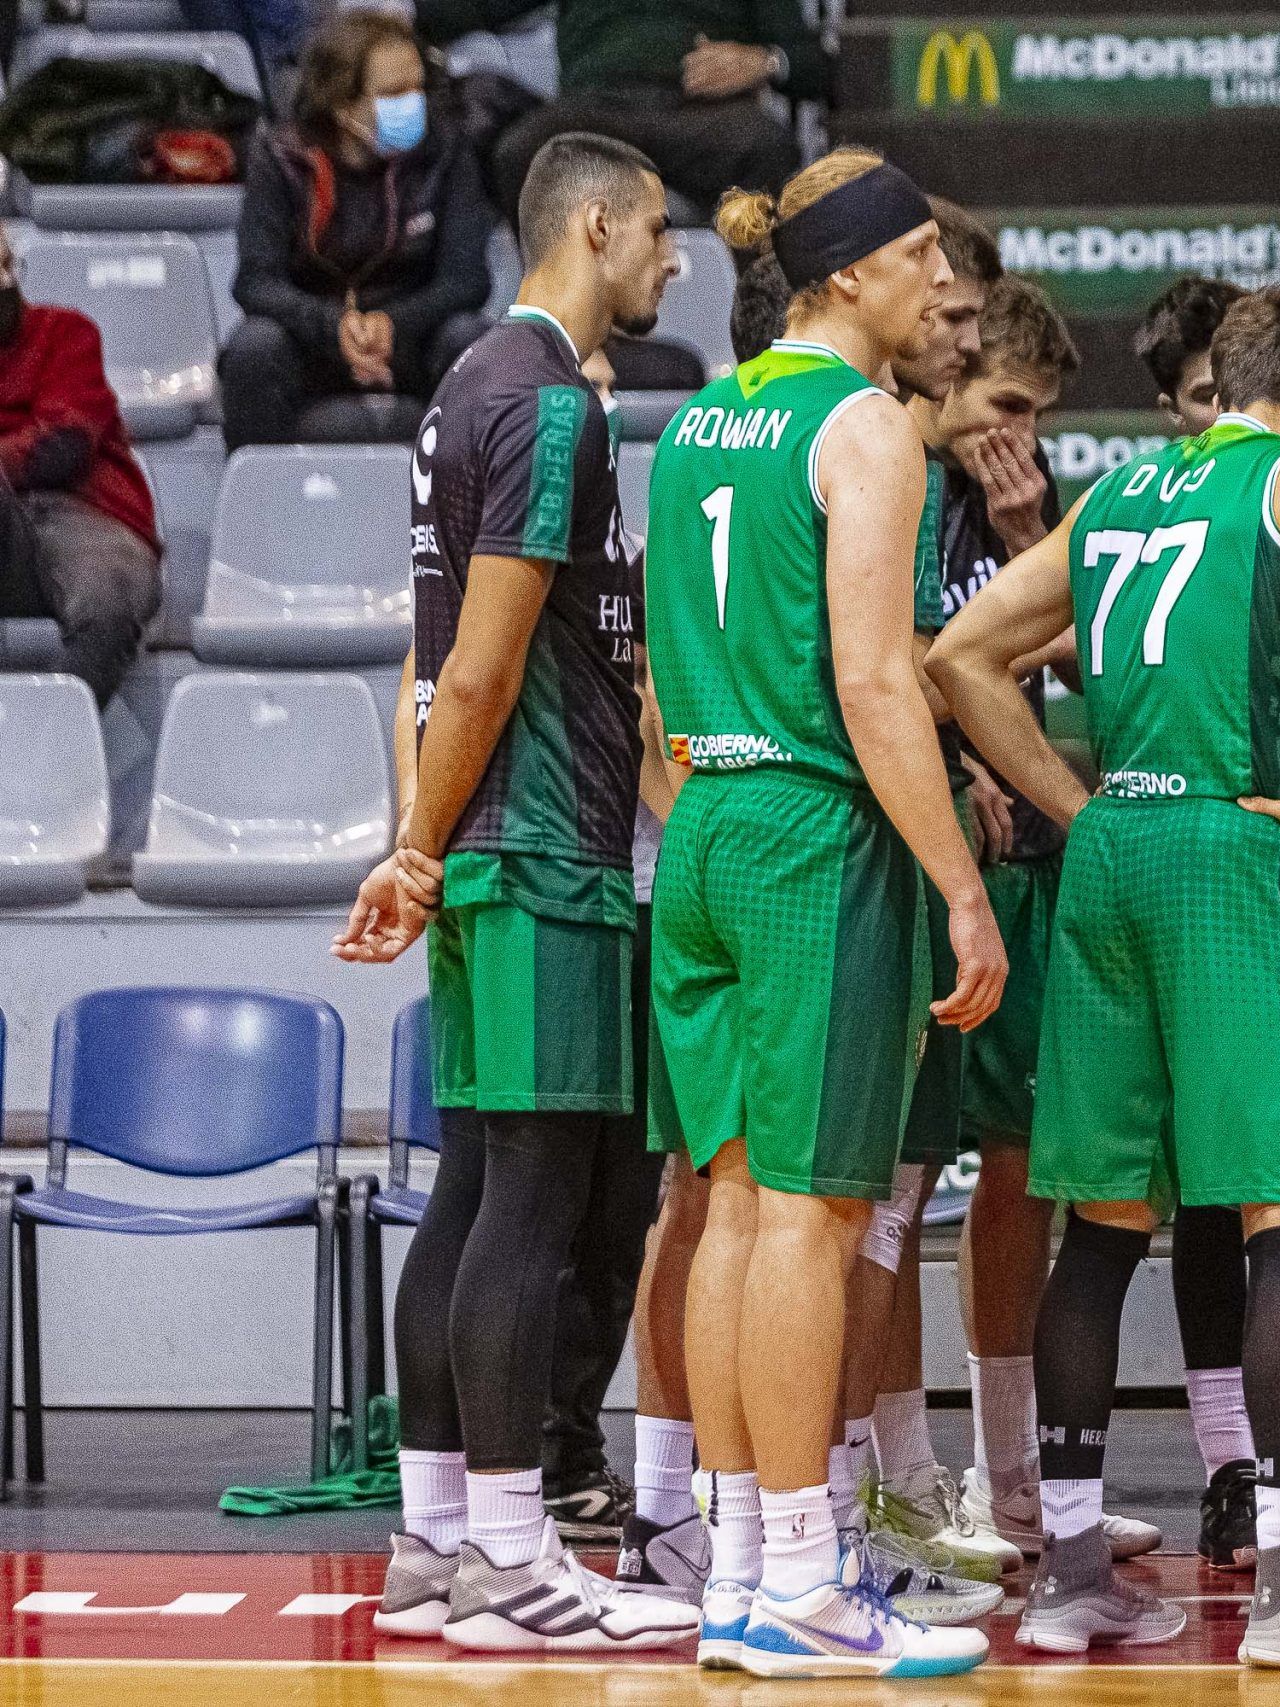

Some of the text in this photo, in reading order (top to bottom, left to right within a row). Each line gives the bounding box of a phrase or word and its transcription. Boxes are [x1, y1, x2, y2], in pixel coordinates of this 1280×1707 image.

[674, 406, 792, 450] ROWAN
[700, 485, 734, 630] 1
[1083, 520, 1209, 677] 77
[689, 733, 780, 757] GOBIERNO
